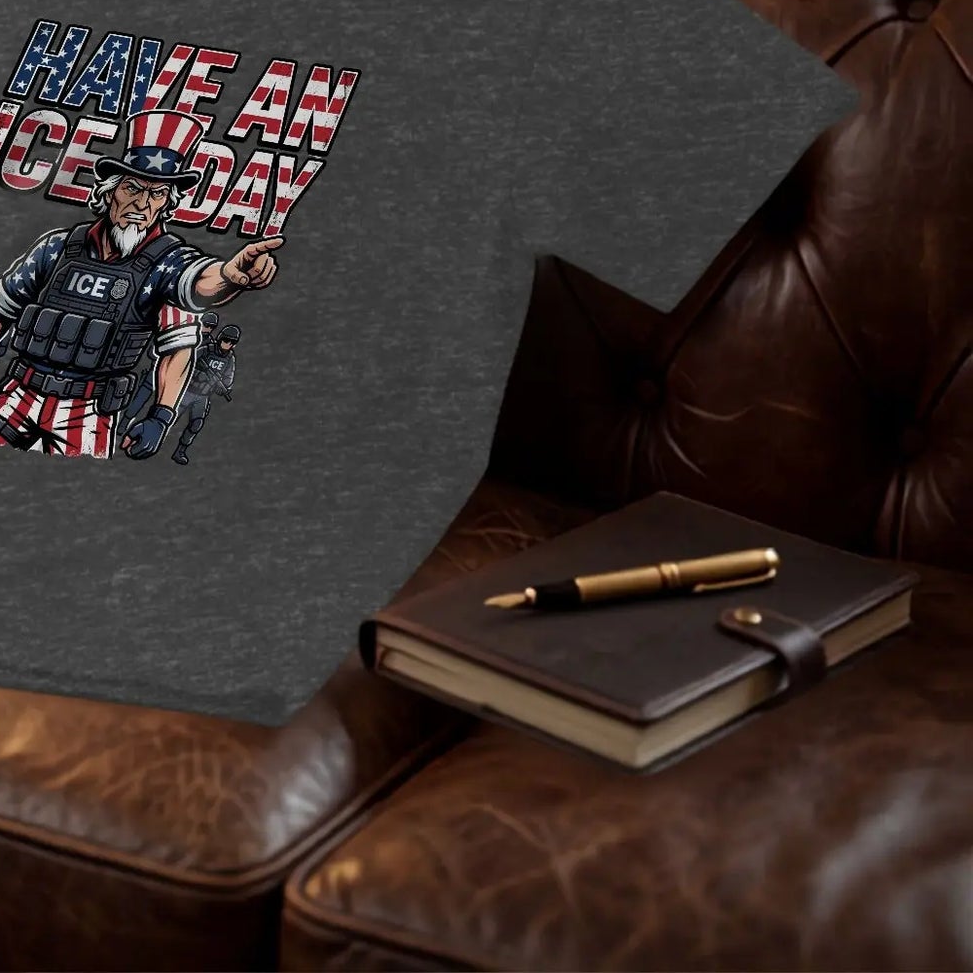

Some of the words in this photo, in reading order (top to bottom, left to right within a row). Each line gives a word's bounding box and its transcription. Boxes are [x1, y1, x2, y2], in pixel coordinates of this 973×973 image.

[6, 20, 240, 130] HAVE
[227, 59, 359, 153] AN
[170, 140, 326, 238] DAY
[67, 272, 110, 298] ICE
[209, 359, 225, 371] ICE
